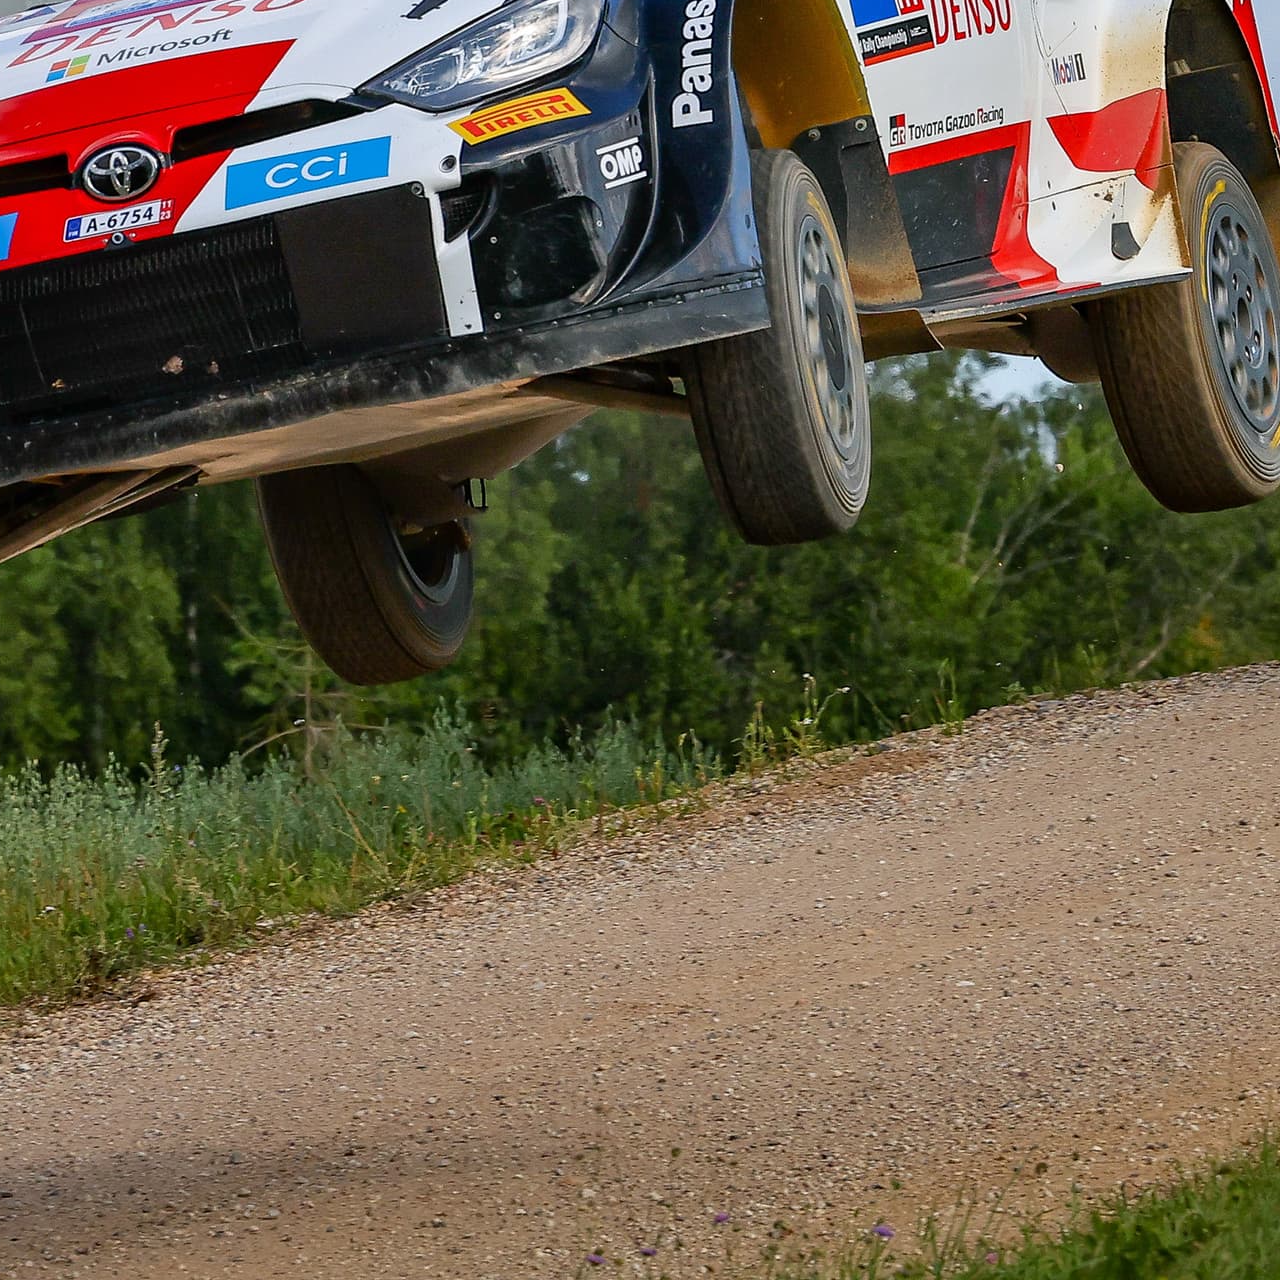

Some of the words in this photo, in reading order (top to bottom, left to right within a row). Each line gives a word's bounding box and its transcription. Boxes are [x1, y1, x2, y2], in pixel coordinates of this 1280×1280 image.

[96, 26, 232, 68] Microsoft
[1051, 54, 1077, 85] Mobil
[460, 94, 576, 137] PIRELLI
[908, 121, 944, 140] TOYOTA
[946, 113, 976, 131] GAZOO
[977, 105, 1004, 125] Racing
[600, 145, 643, 180] OMP
[86, 206, 154, 233] A-6754
